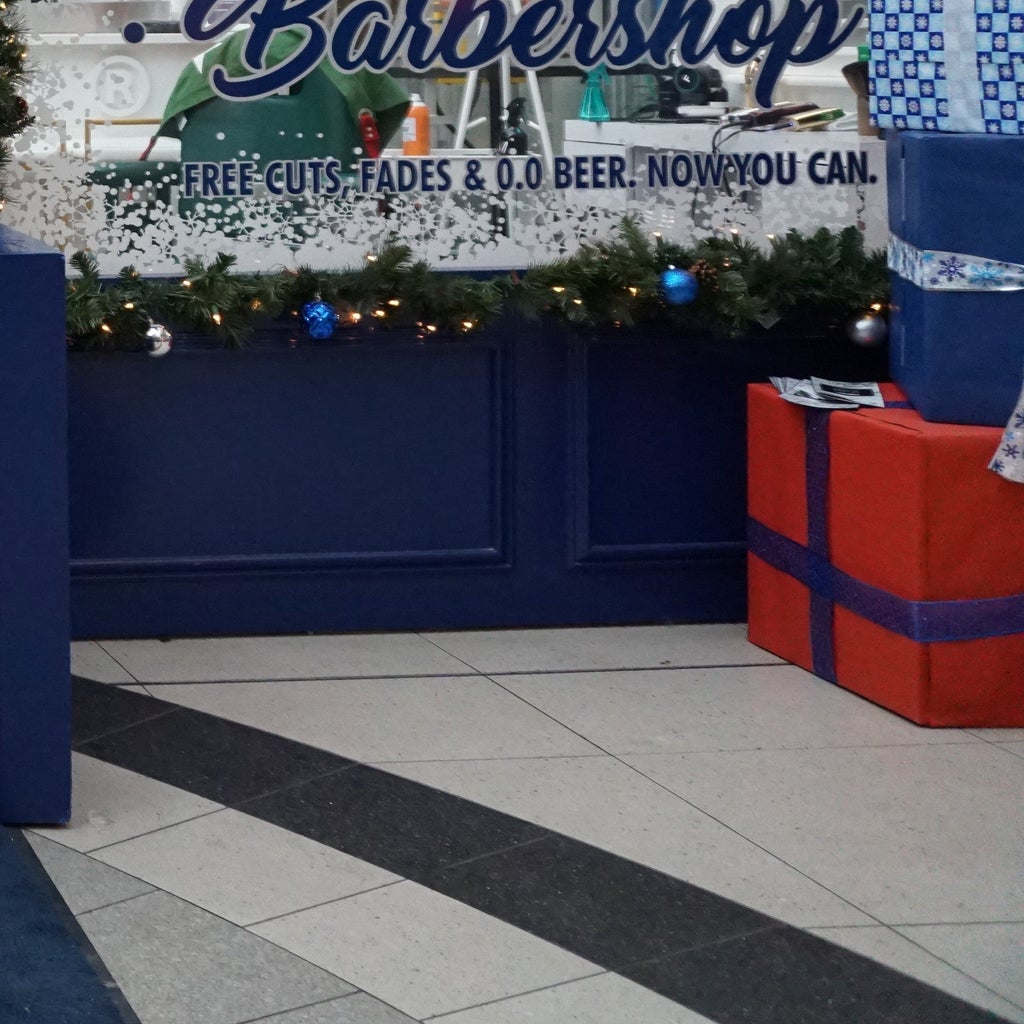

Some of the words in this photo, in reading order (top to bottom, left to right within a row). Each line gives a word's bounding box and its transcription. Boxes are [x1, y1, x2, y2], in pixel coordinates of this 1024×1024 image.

[184, 161, 255, 198] FREE
[265, 157, 348, 199] CUTS,
[359, 157, 452, 193] FADES
[463, 157, 487, 192] &
[495, 156, 544, 192] 0.0
[553, 155, 637, 190] BEER.
[648, 153, 725, 188] NOW
[730, 152, 795, 186] YOU
[808, 150, 877, 185] CAN.
